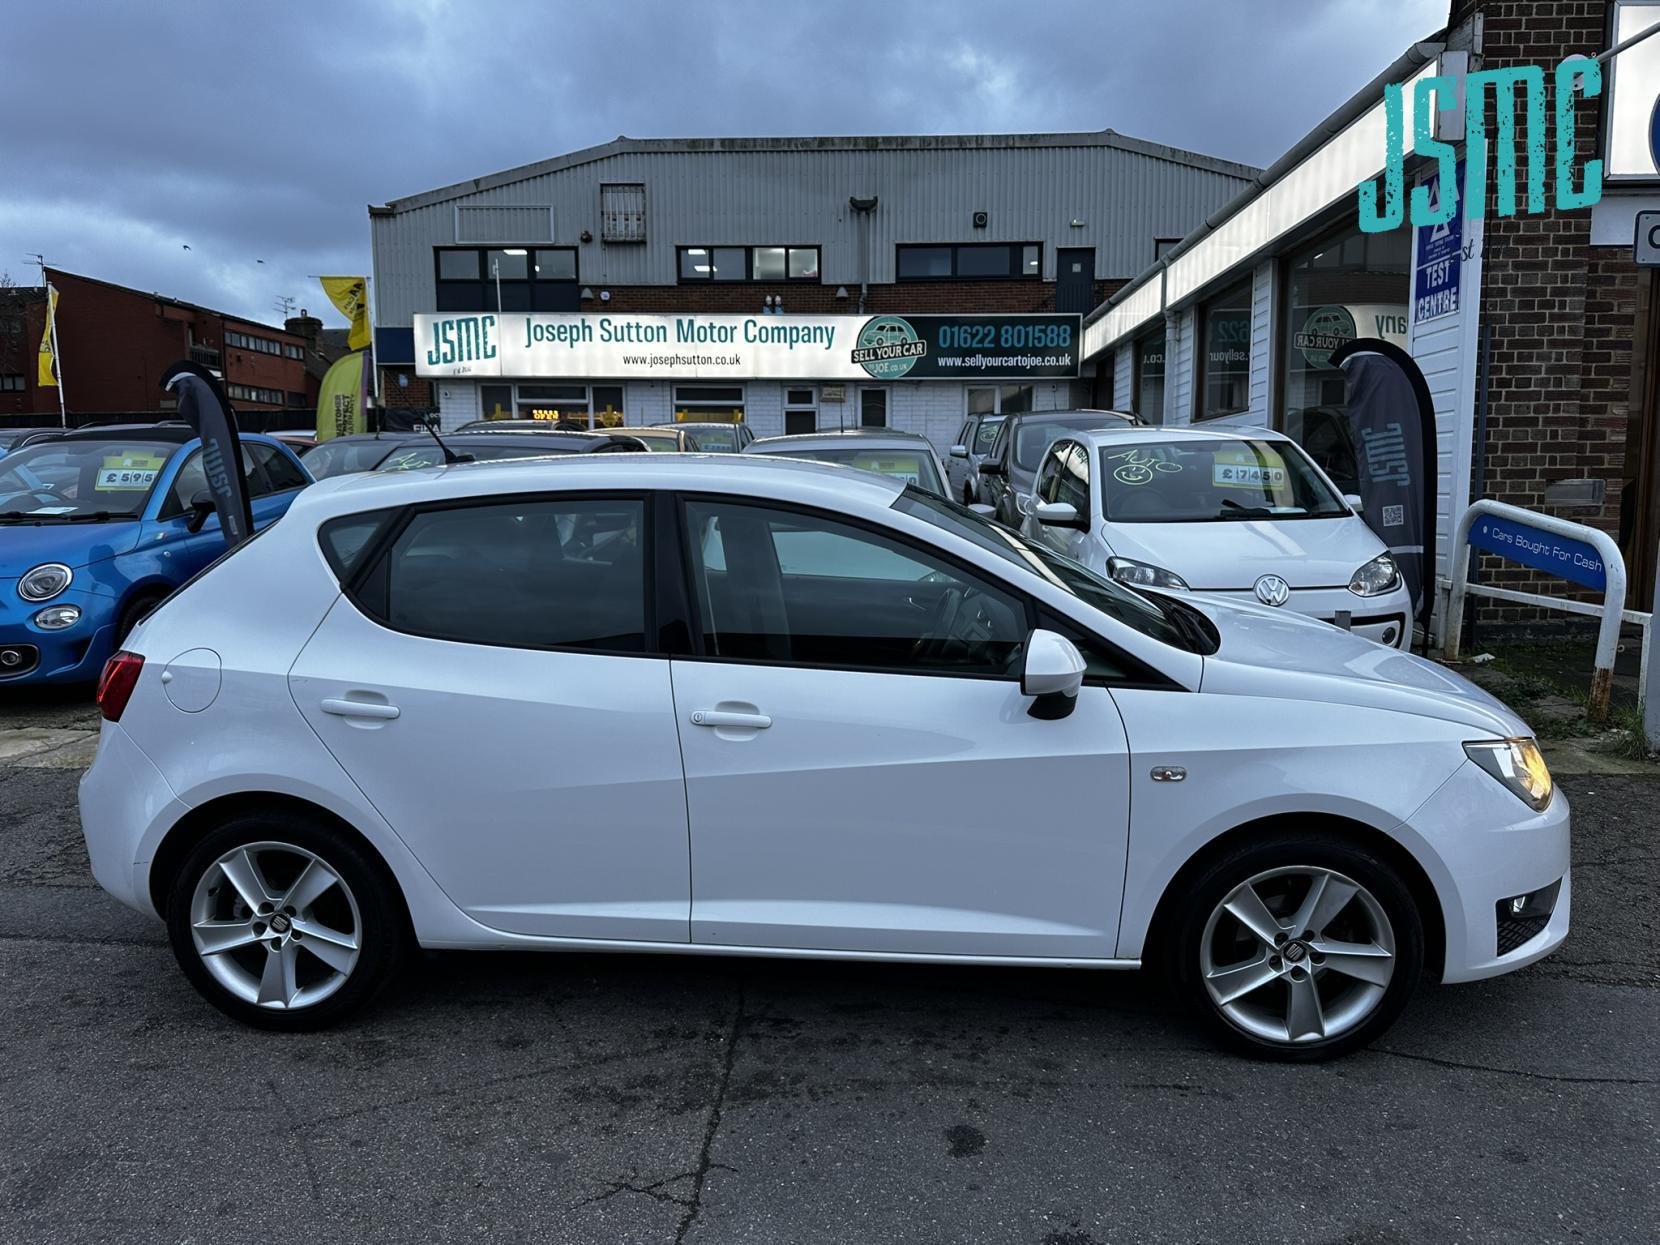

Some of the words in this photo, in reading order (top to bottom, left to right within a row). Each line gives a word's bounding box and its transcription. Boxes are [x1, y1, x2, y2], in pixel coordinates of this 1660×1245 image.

[1425, 262, 1450, 289] TEST
[1418, 287, 1457, 321] CENTRE
[427, 315, 497, 365] JSMC
[525, 317, 593, 348] Joseph
[600, 318, 667, 343] Sutton
[676, 318, 737, 343] Motor
[744, 319, 835, 349] Company
[939, 325, 995, 348] 01622
[1000, 325, 1071, 348] 801588
[622, 352, 741, 368] www.josephsutton.co.uk
[853, 350, 875, 362] SELL
[876, 346, 902, 359] YOUR
[903, 343, 923, 356] CAR
[937, 353, 1071, 370] www.sellyourcartojoe.co.uk
[1361, 422, 1411, 487] JSMC
[1491, 527, 1512, 544] Cars
[1515, 536, 1549, 555] Bought
[1552, 546, 1571, 561] For
[1573, 553, 1602, 572] Cash
